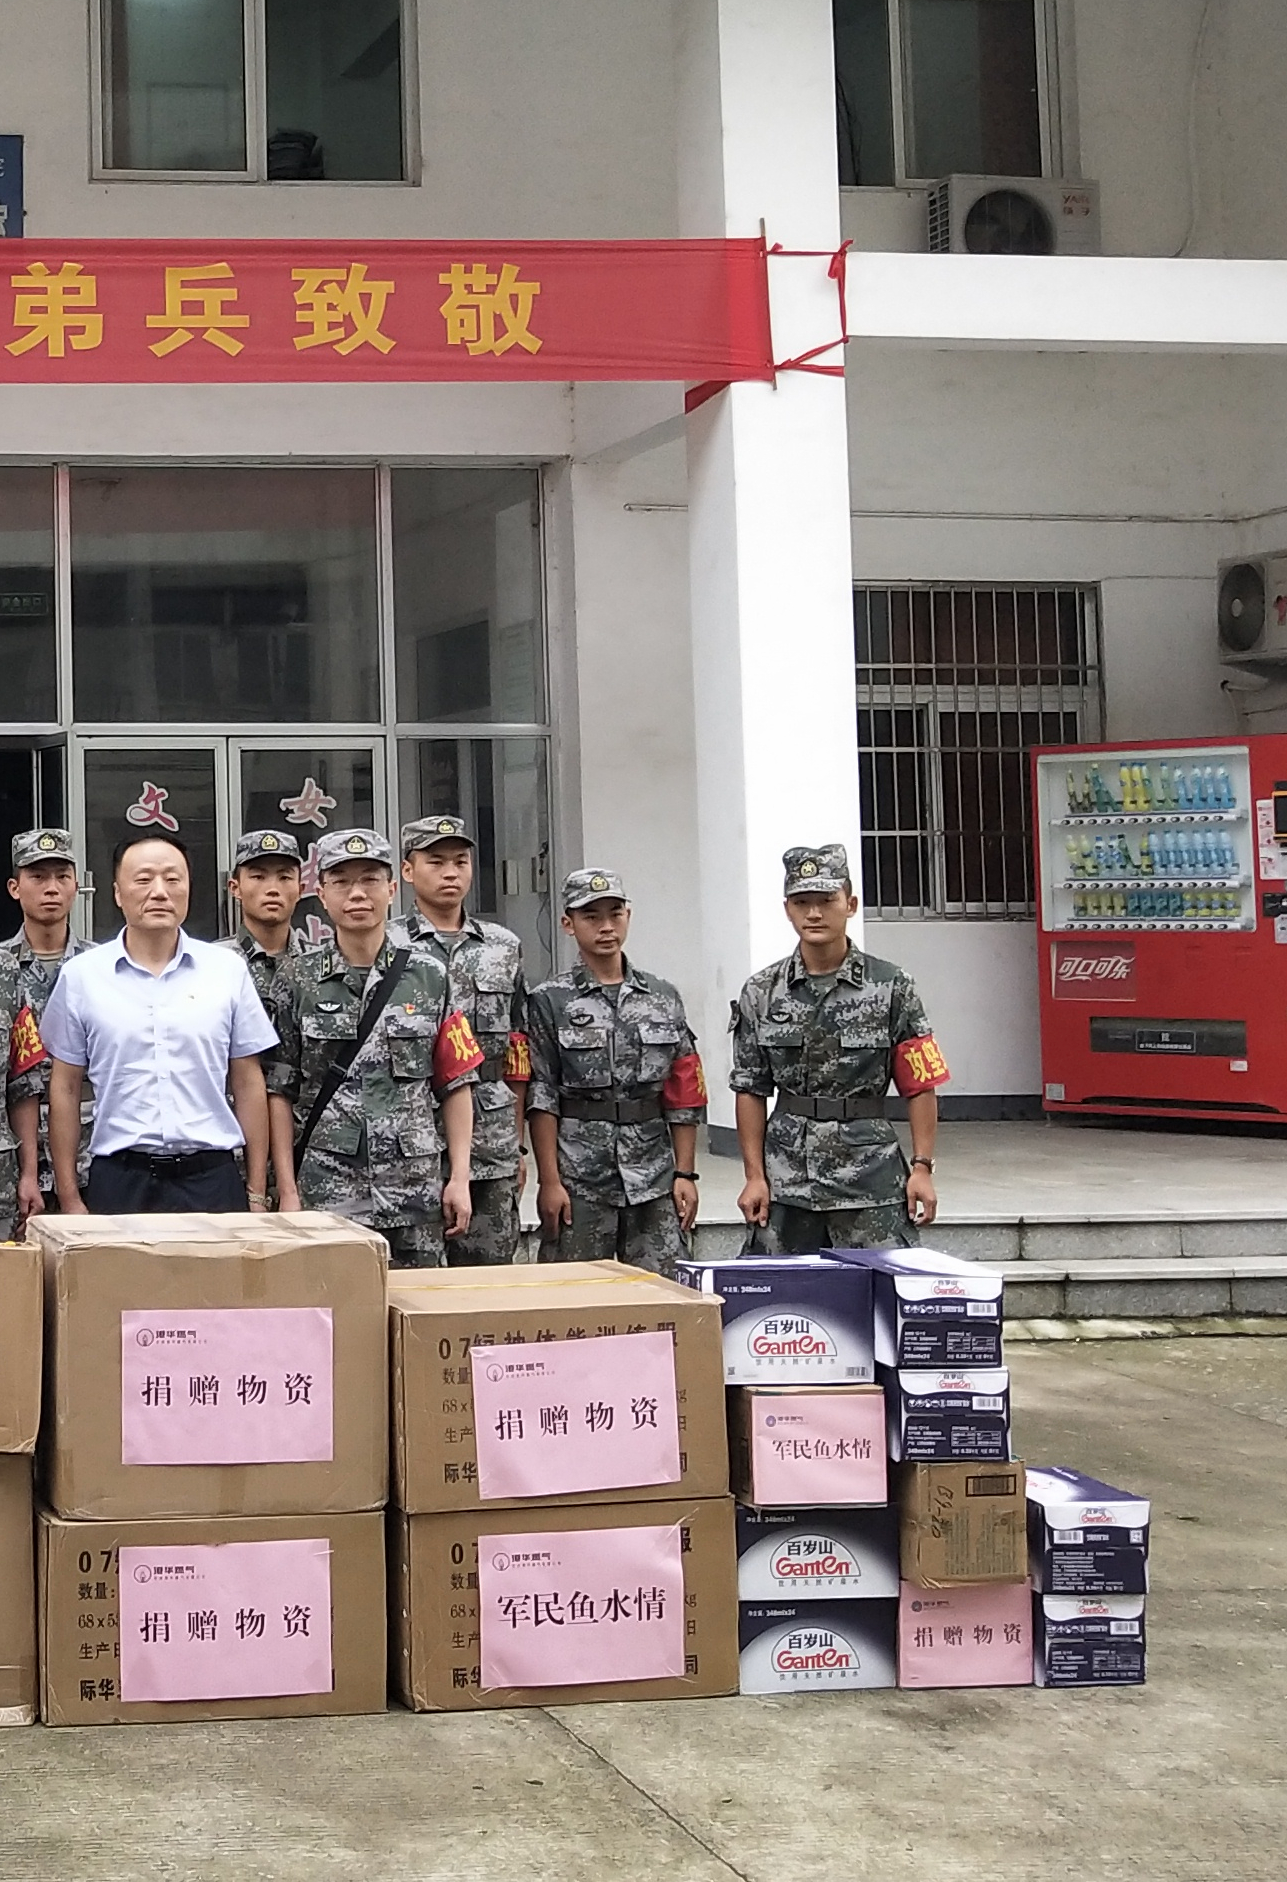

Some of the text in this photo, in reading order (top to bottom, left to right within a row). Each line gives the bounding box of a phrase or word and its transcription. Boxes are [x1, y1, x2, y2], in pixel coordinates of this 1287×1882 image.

[1057, 955, 1135, 981] 可口可乐
[763, 1320, 811, 1335] 百岁山
[141, 1372, 313, 1406] 捐赠物资
[442, 1398, 473, 1414] 68x
[495, 1396, 659, 1441] 捐赠物资
[445, 1425, 473, 1443] 生产
[772, 1437, 872, 1461] 军民鱼水情
[444, 1462, 477, 1483] 际华
[787, 1540, 833, 1556] 百岁山
[78, 1550, 119, 1573] 07
[497, 1586, 667, 1629] 军民鱼水情
[78, 1612, 119, 1629] 68x5
[139, 1604, 312, 1643] 捐赠物资
[789, 1633, 833, 1649] 百岁山
[913, 1623, 1022, 1648] 捐赠物资
[80, 1678, 122, 1702] 际华
